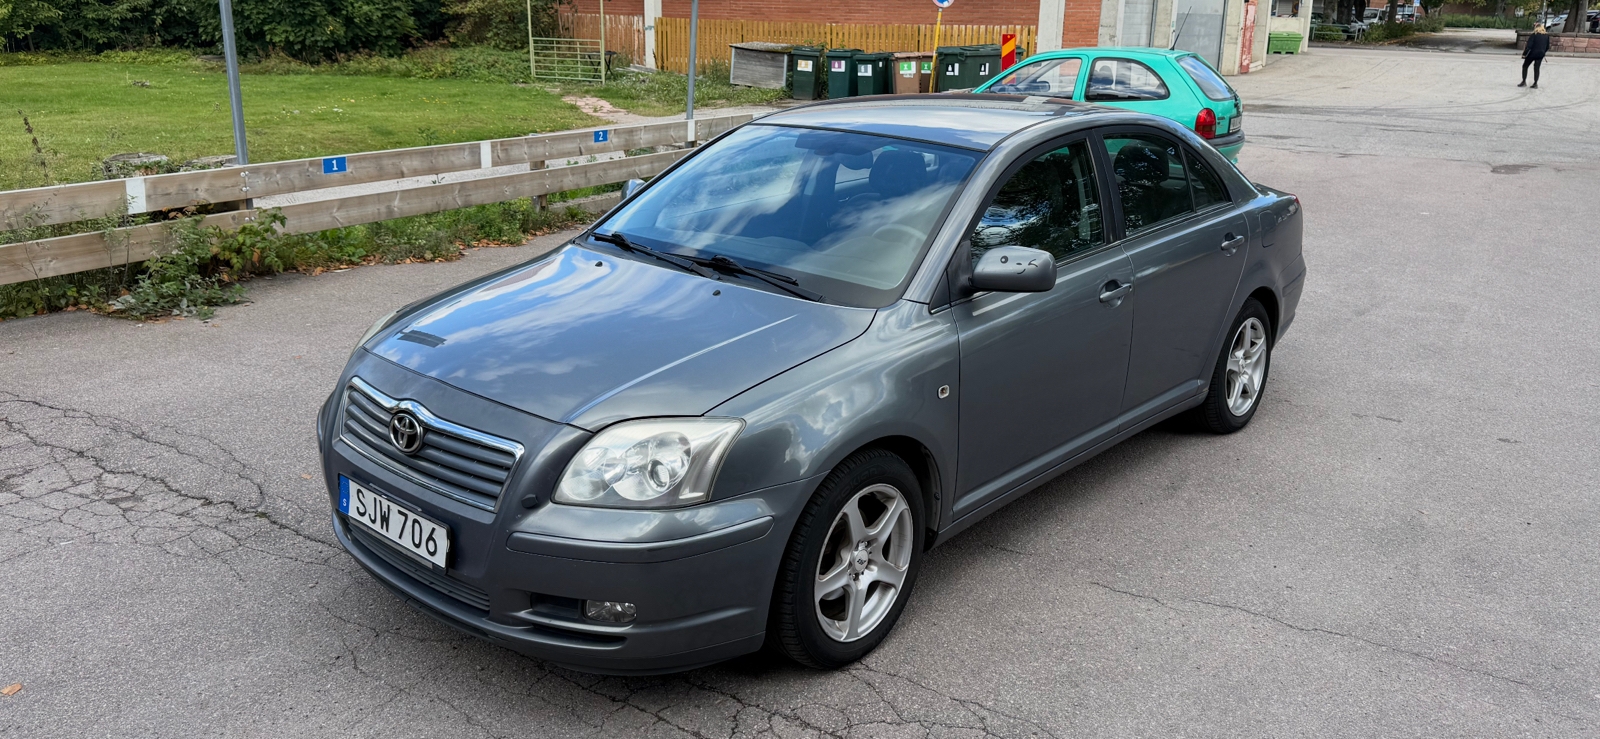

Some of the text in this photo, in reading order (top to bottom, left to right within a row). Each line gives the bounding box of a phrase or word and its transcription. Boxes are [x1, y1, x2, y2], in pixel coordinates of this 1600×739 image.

[598, 131, 604, 141] 2
[331, 159, 339, 171] 1
[342, 498, 347, 507] S
[356, 488, 438, 557] SJW 706
